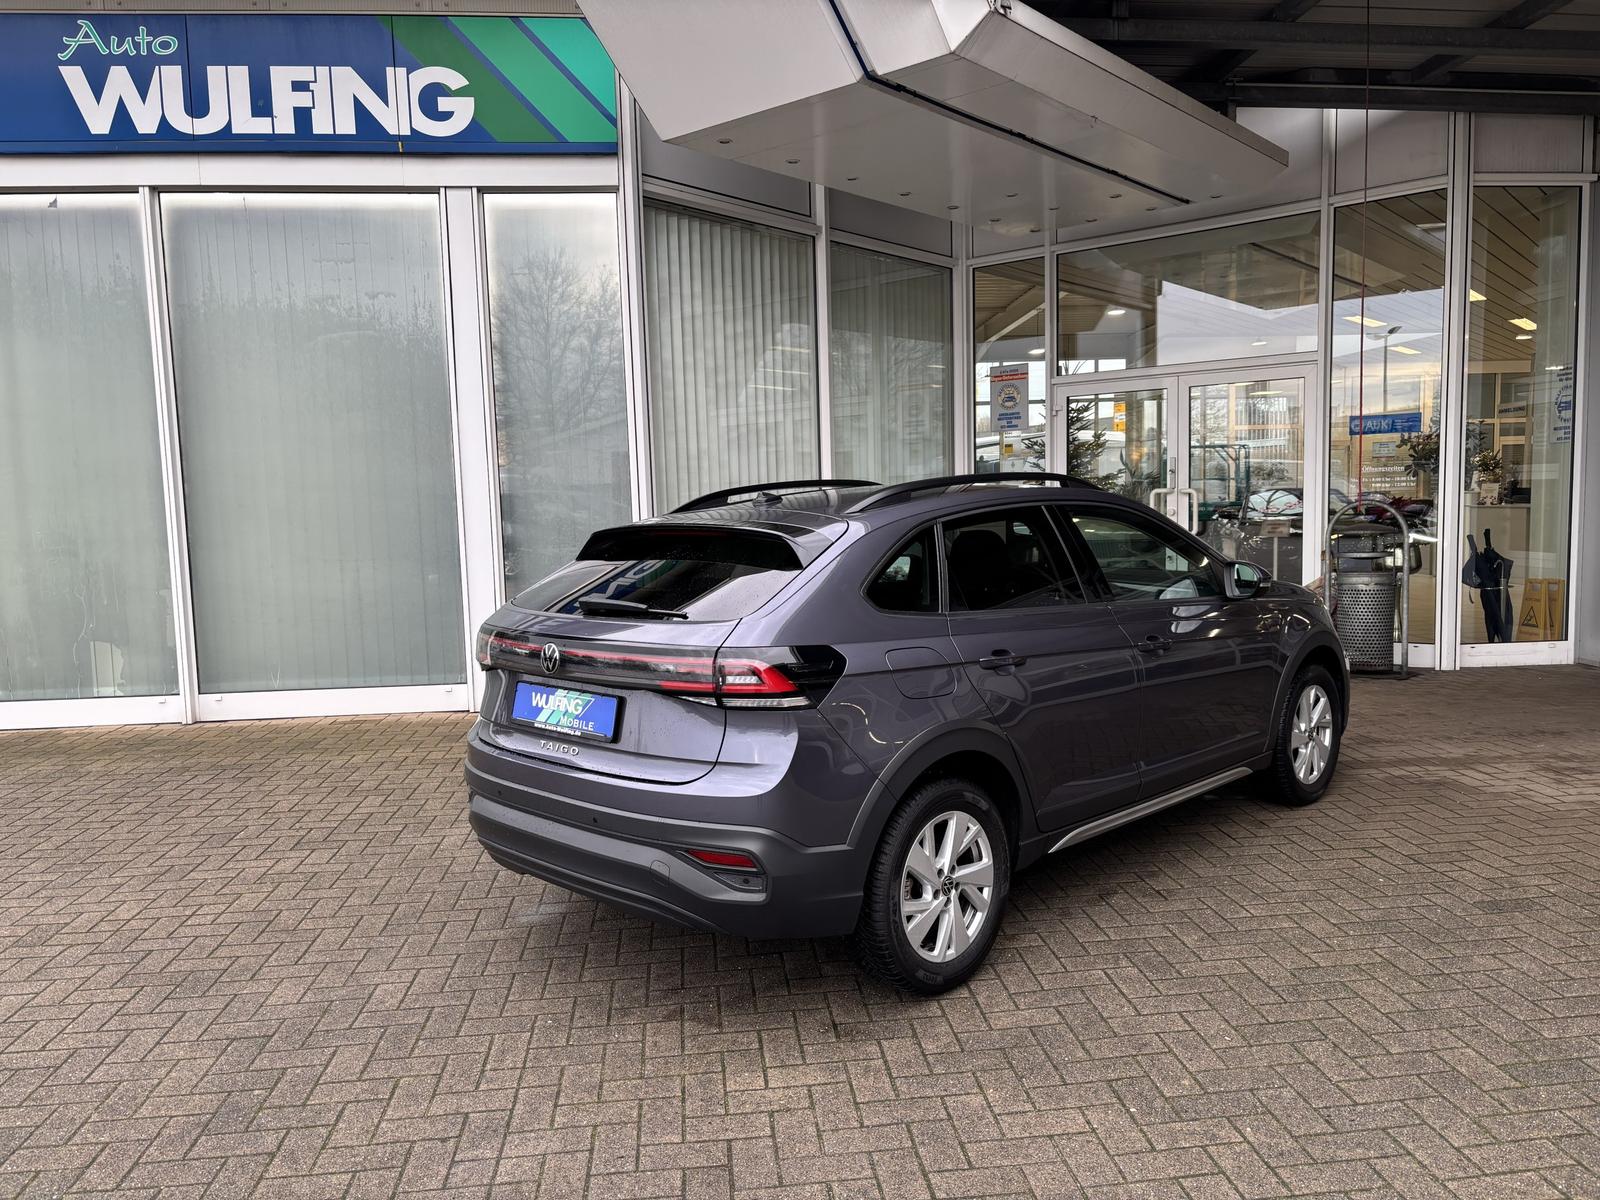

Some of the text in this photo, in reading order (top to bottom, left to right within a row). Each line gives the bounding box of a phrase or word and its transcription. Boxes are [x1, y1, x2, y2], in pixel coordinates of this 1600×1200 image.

[57, 20, 179, 60] Auto
[57, 65, 475, 137] WULFING
[531, 691, 583, 715] WULFING
[559, 716, 595, 731] MOBILE
[540, 740, 579, 755] TAIGO
